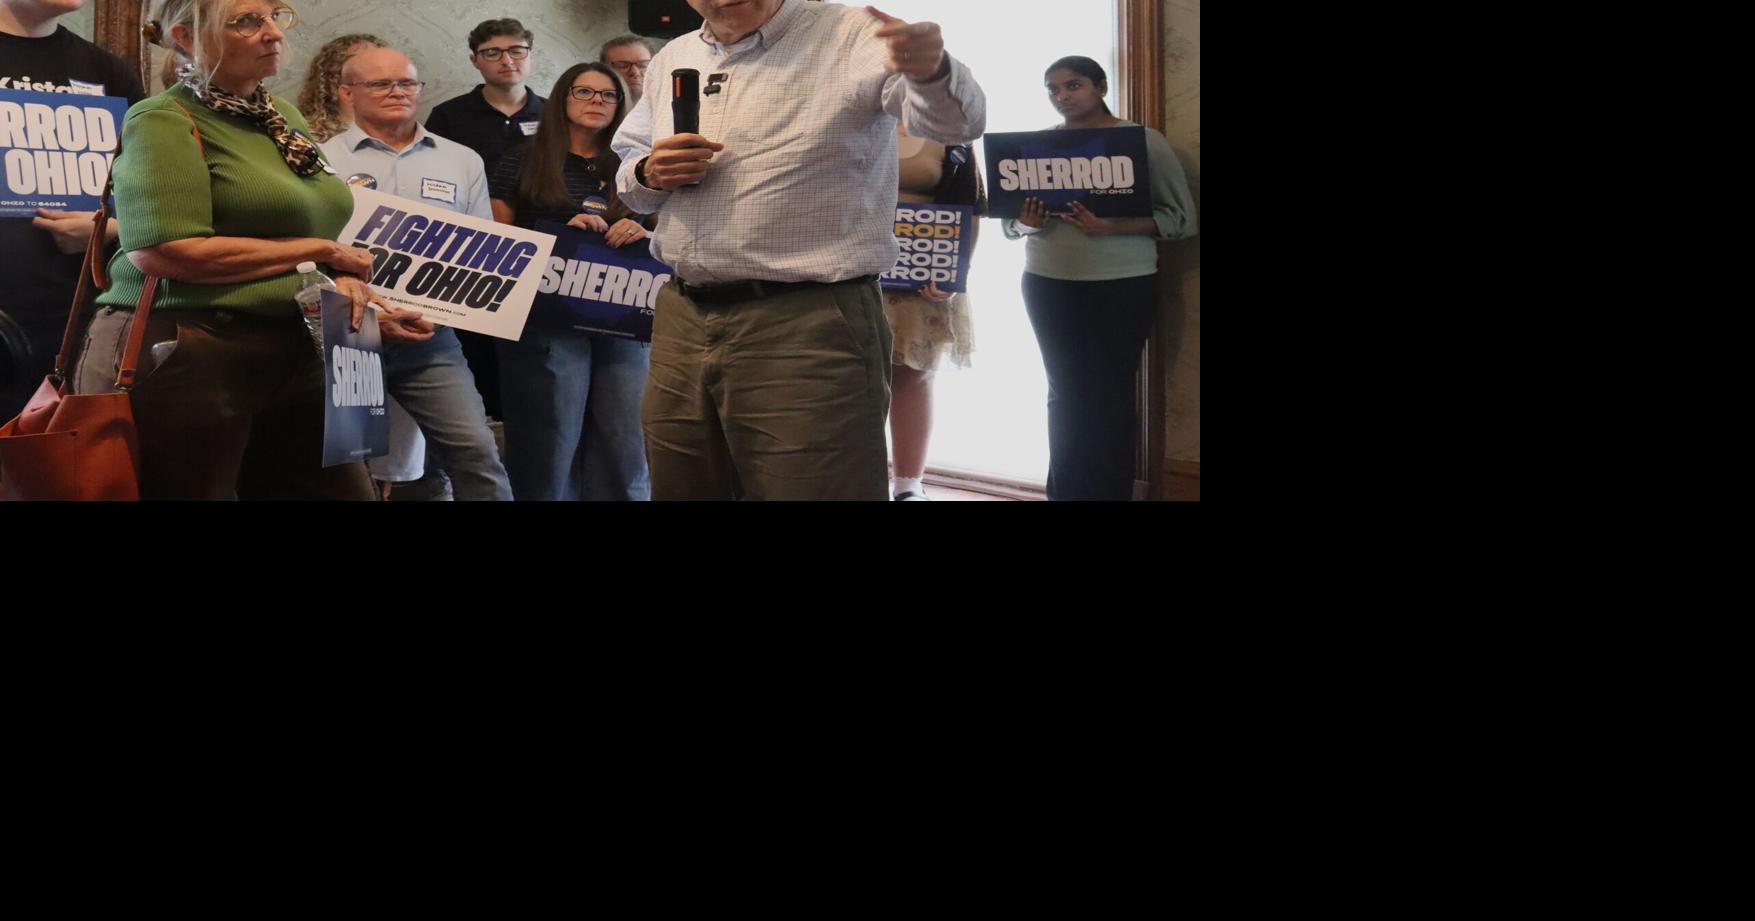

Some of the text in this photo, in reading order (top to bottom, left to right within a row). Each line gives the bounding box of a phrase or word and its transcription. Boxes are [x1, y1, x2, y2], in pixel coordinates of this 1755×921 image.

[998, 155, 1135, 192] SHERROD
[355, 205, 538, 278] FIGHTING
[405, 261, 517, 313] OHIO!
[333, 345, 384, 407] SHERROD
